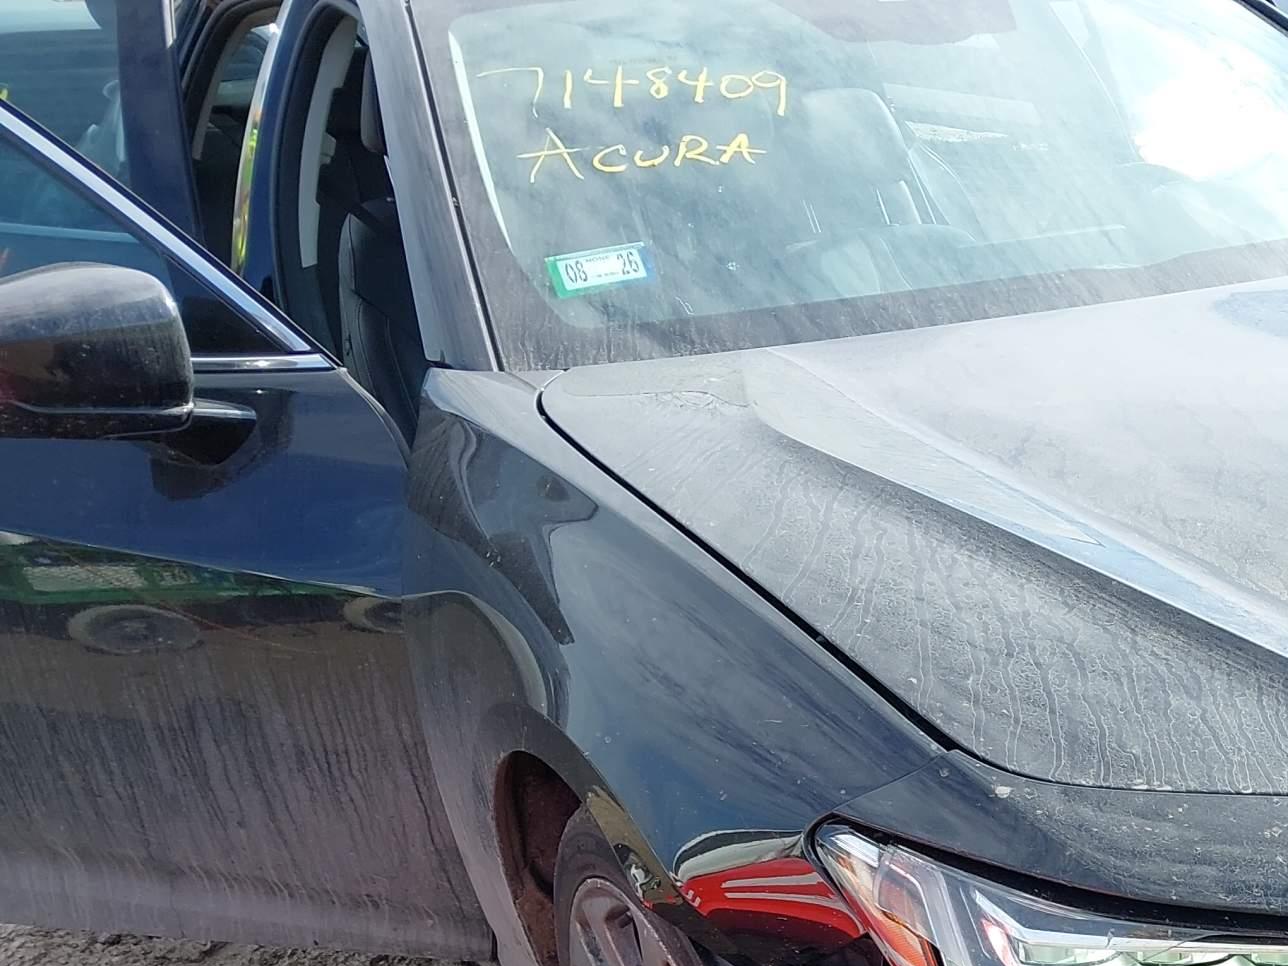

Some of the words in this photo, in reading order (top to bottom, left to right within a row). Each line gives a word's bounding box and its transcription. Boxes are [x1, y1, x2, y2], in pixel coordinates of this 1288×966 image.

[476, 65, 787, 118] 7148409
[516, 127, 767, 183] ACURA
[564, 260, 588, 283] 08
[616, 250, 640, 275] 26
